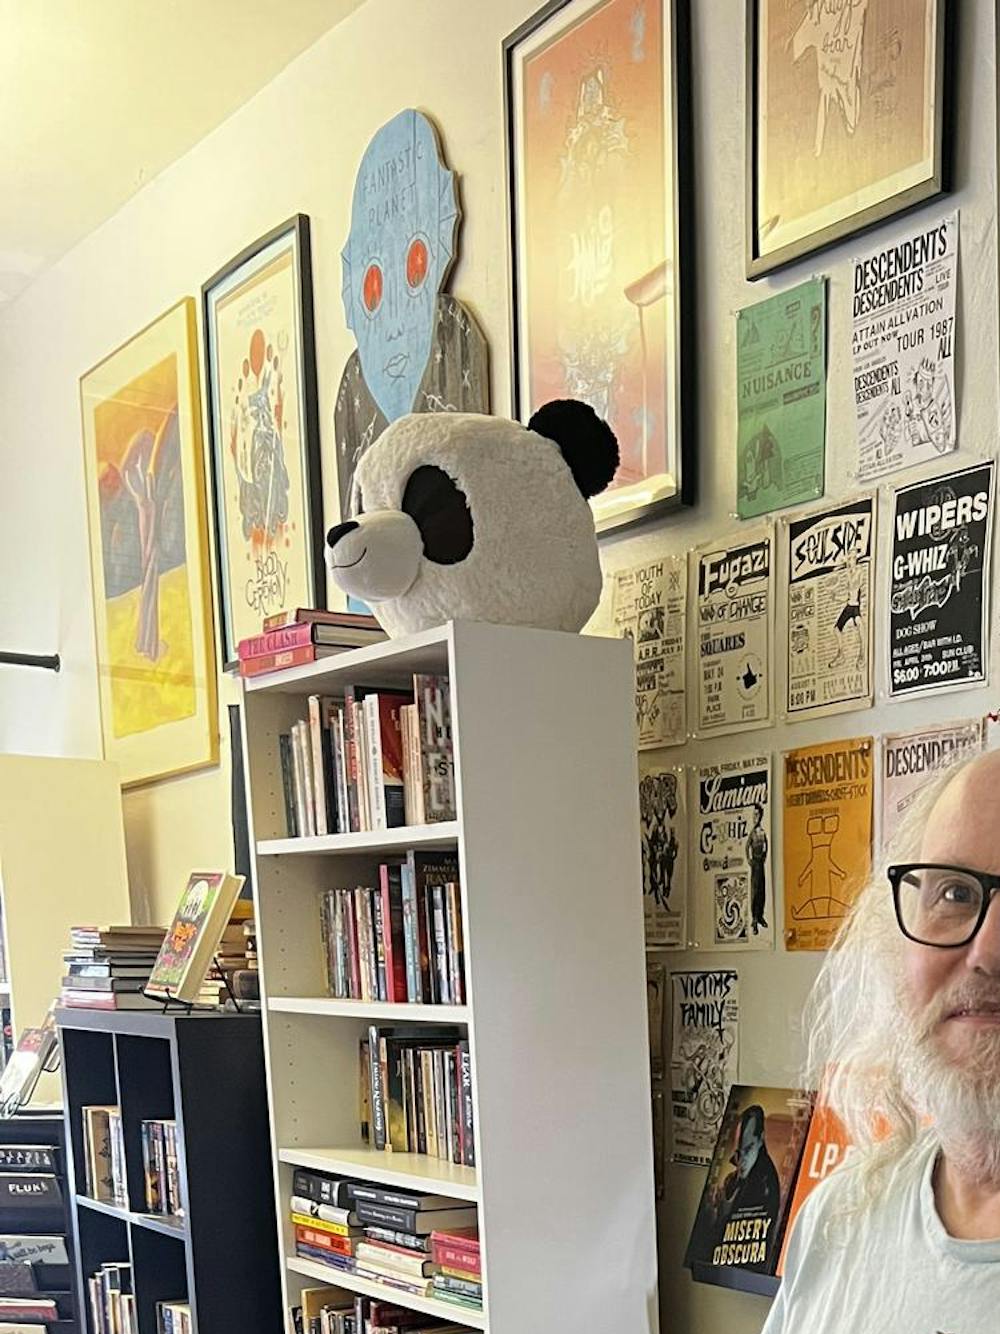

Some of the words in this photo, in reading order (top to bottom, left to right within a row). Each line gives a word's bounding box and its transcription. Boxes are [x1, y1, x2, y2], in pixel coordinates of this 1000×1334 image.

[854, 223, 948, 295] DESCENDENTS
[853, 267, 924, 318] DESCENDENTS
[896, 328, 925, 353] TOUR
[930, 316, 954, 341] 1987
[742, 361, 812, 398] NUISANCE
[896, 491, 988, 542] WIPERS
[700, 539, 770, 600] Fugazi
[893, 543, 949, 582] G-WHIZ
[633, 591, 662, 611] TODAY
[682, 973, 738, 999] VICTIMS
[681, 999, 726, 1042] FAMILY
[723, 1217, 772, 1242] MISERY
[712, 1240, 767, 1266] OBSCURA
